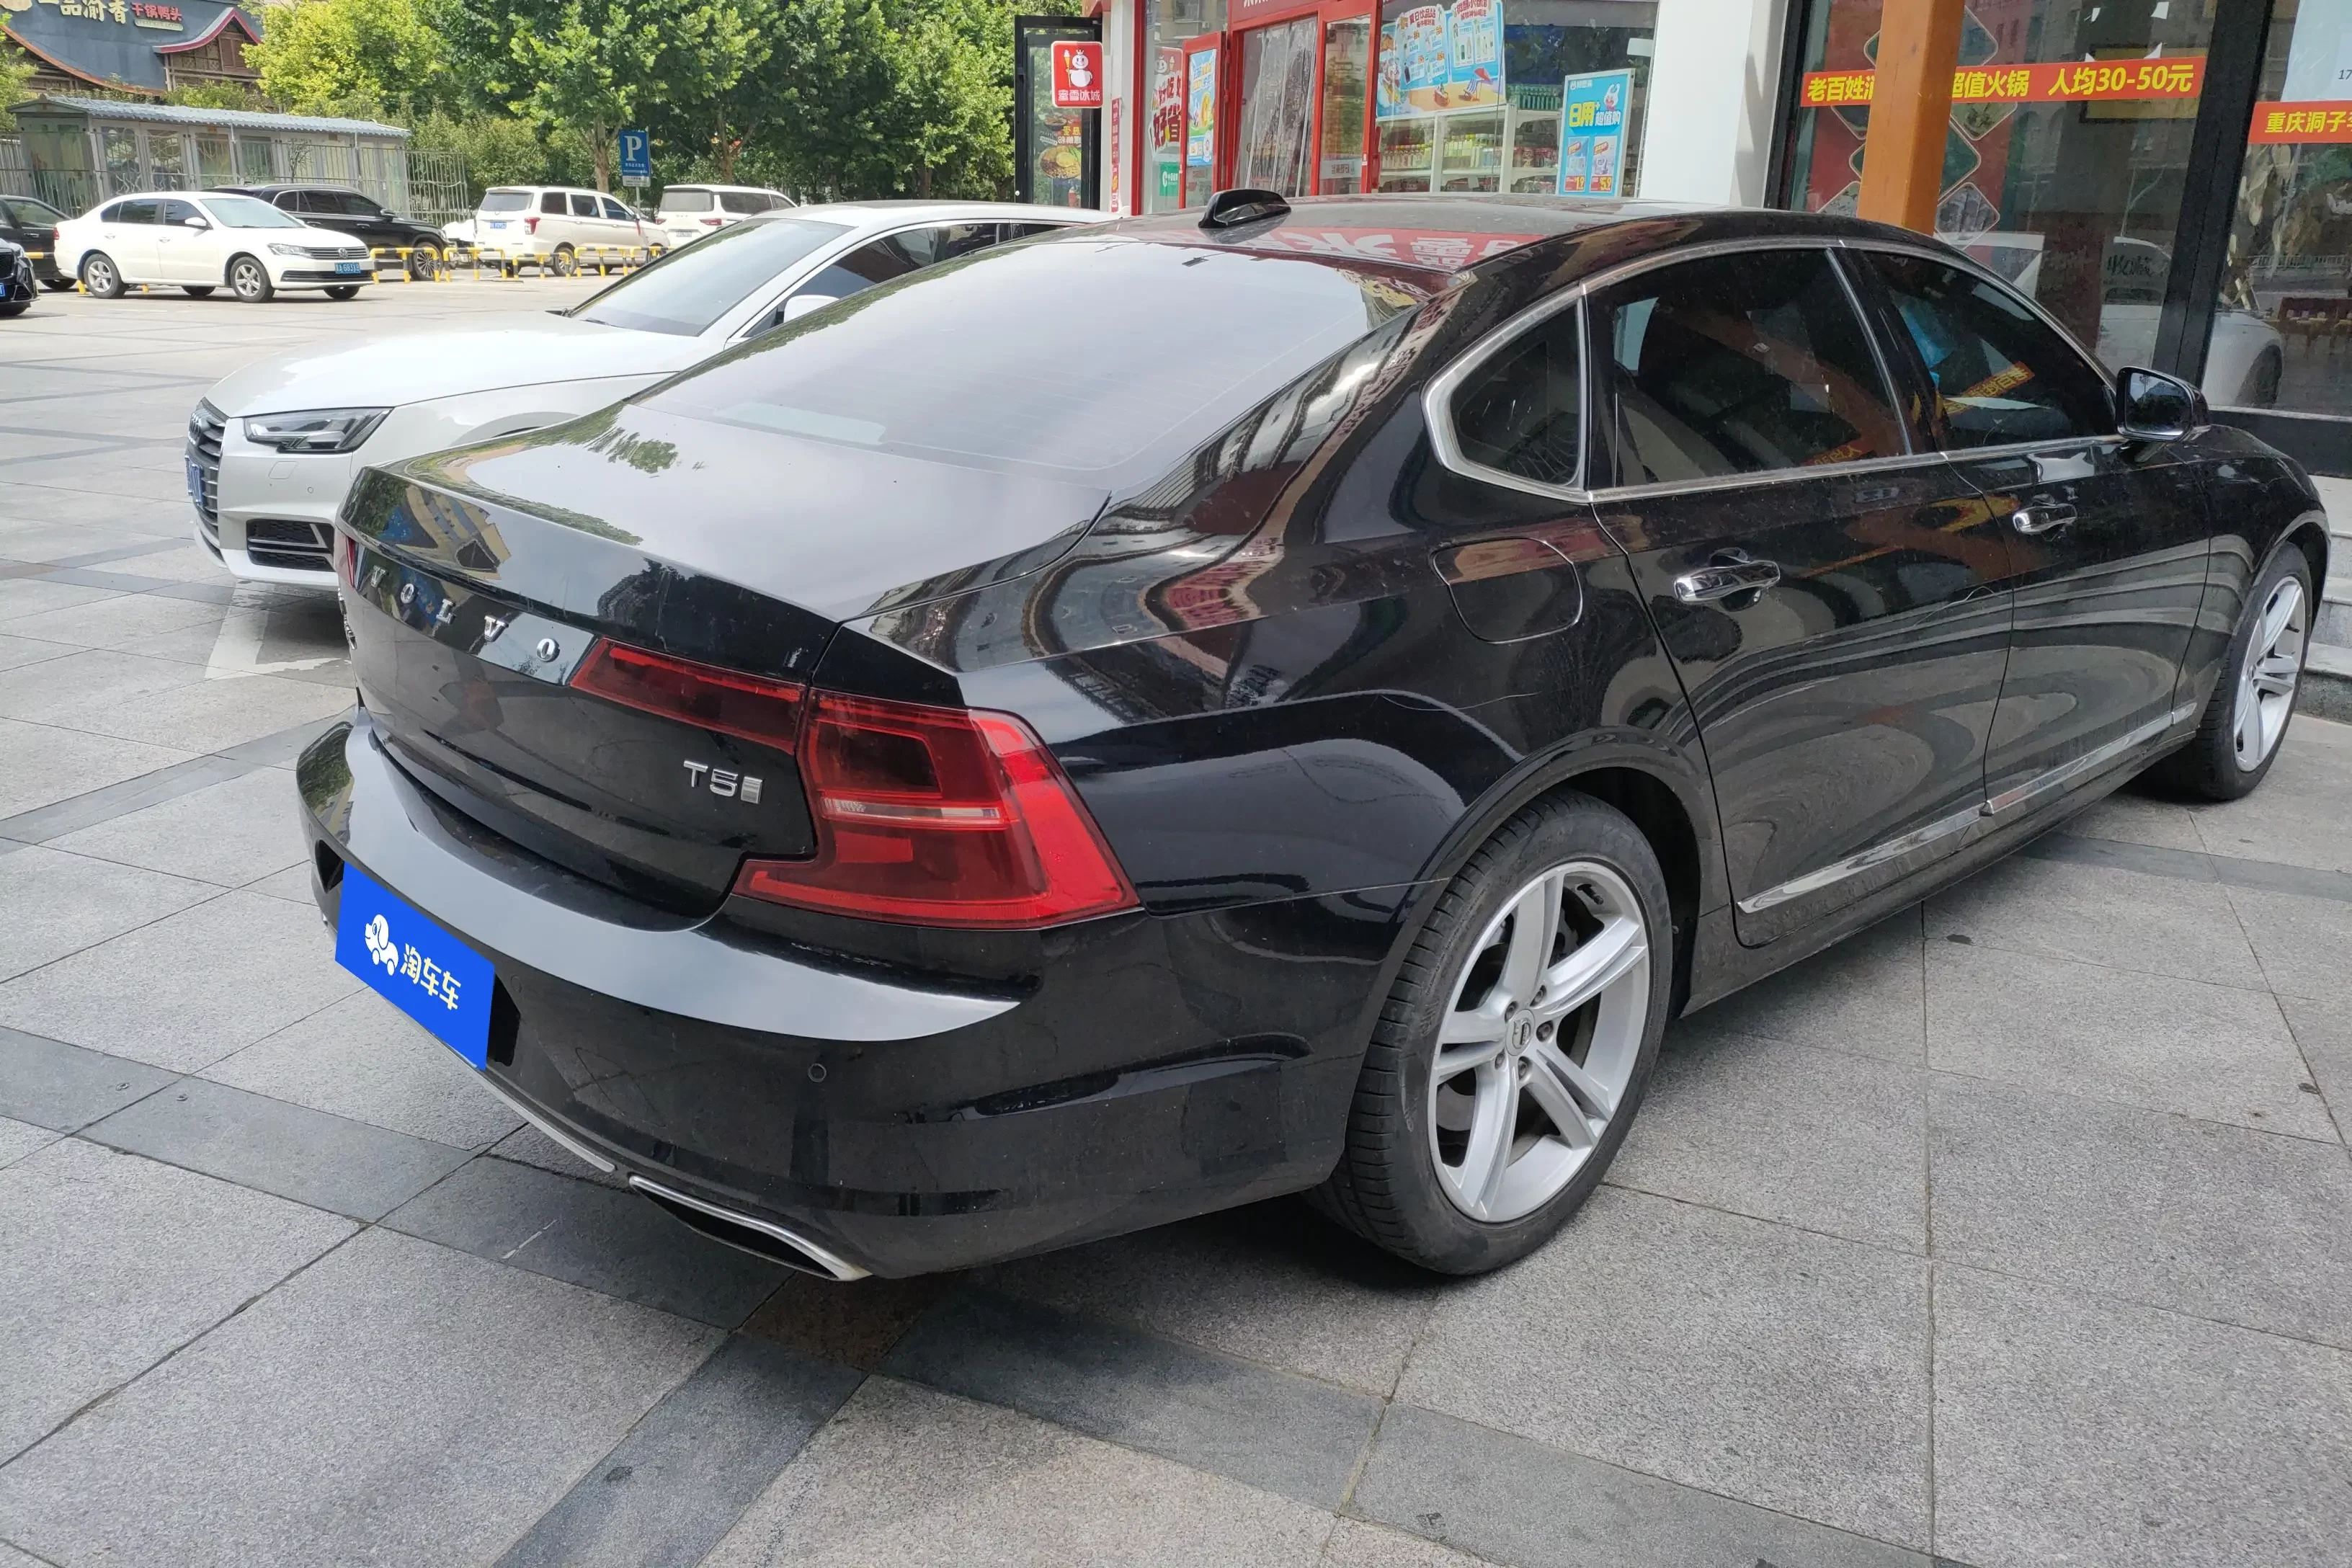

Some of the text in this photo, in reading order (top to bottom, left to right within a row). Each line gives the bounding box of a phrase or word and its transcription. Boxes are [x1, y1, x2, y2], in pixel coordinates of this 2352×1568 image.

[2048, 64, 2193, 95] 人均30-50元
[1058, 89, 1100, 101] 蜜雪冰城
[1569, 102, 1595, 127] 日用
[624, 135, 642, 161] P
[370, 564, 561, 663] VOLVO
[683, 760, 738, 797] T5
